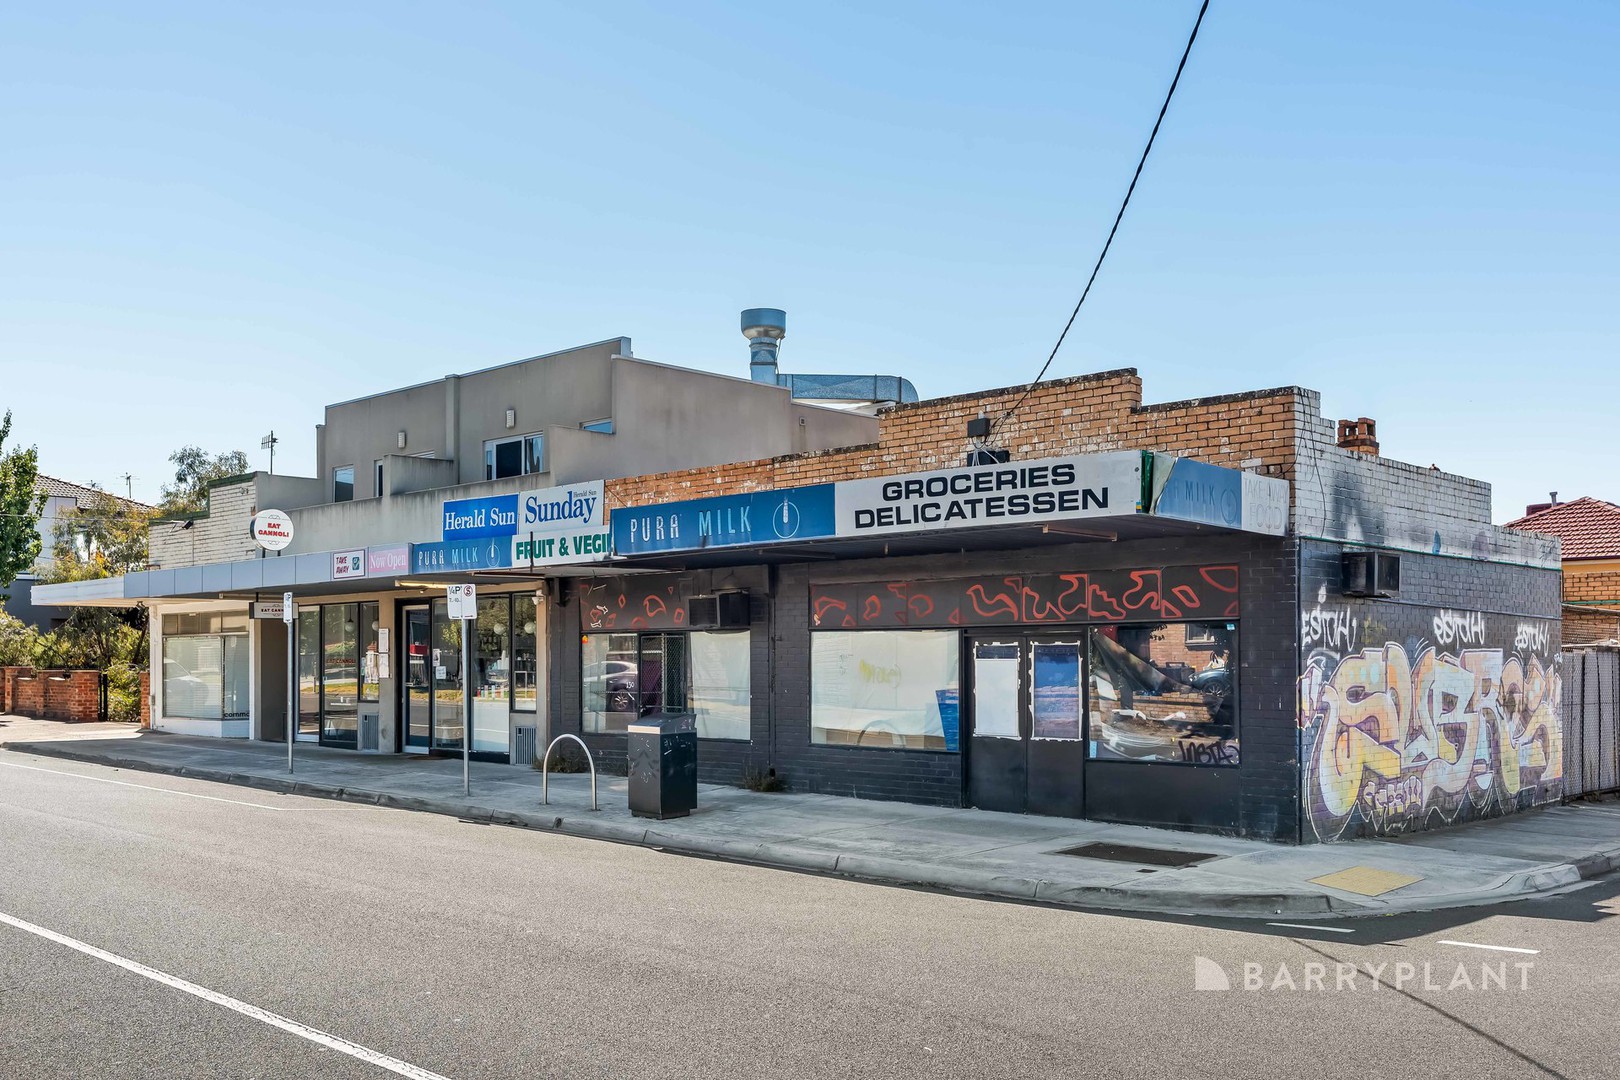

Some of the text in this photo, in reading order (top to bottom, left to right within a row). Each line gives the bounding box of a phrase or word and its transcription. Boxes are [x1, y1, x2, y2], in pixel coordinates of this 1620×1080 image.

[882, 463, 1075, 501] GROCERIES
[1185, 479, 1216, 506] MILK
[444, 507, 516, 531] Herald Sun
[525, 490, 597, 524] Sunday
[854, 486, 1109, 529] DELICATESSEN
[258, 529, 290, 538] CANNOLI
[267, 522, 281, 530] EAT
[630, 505, 751, 543] PURA MILK
[418, 547, 478, 566] PURA MILK
[516, 537, 554, 560] FRUIT
[559, 536, 569, 557] &
[370, 552, 406, 570] Now Open
